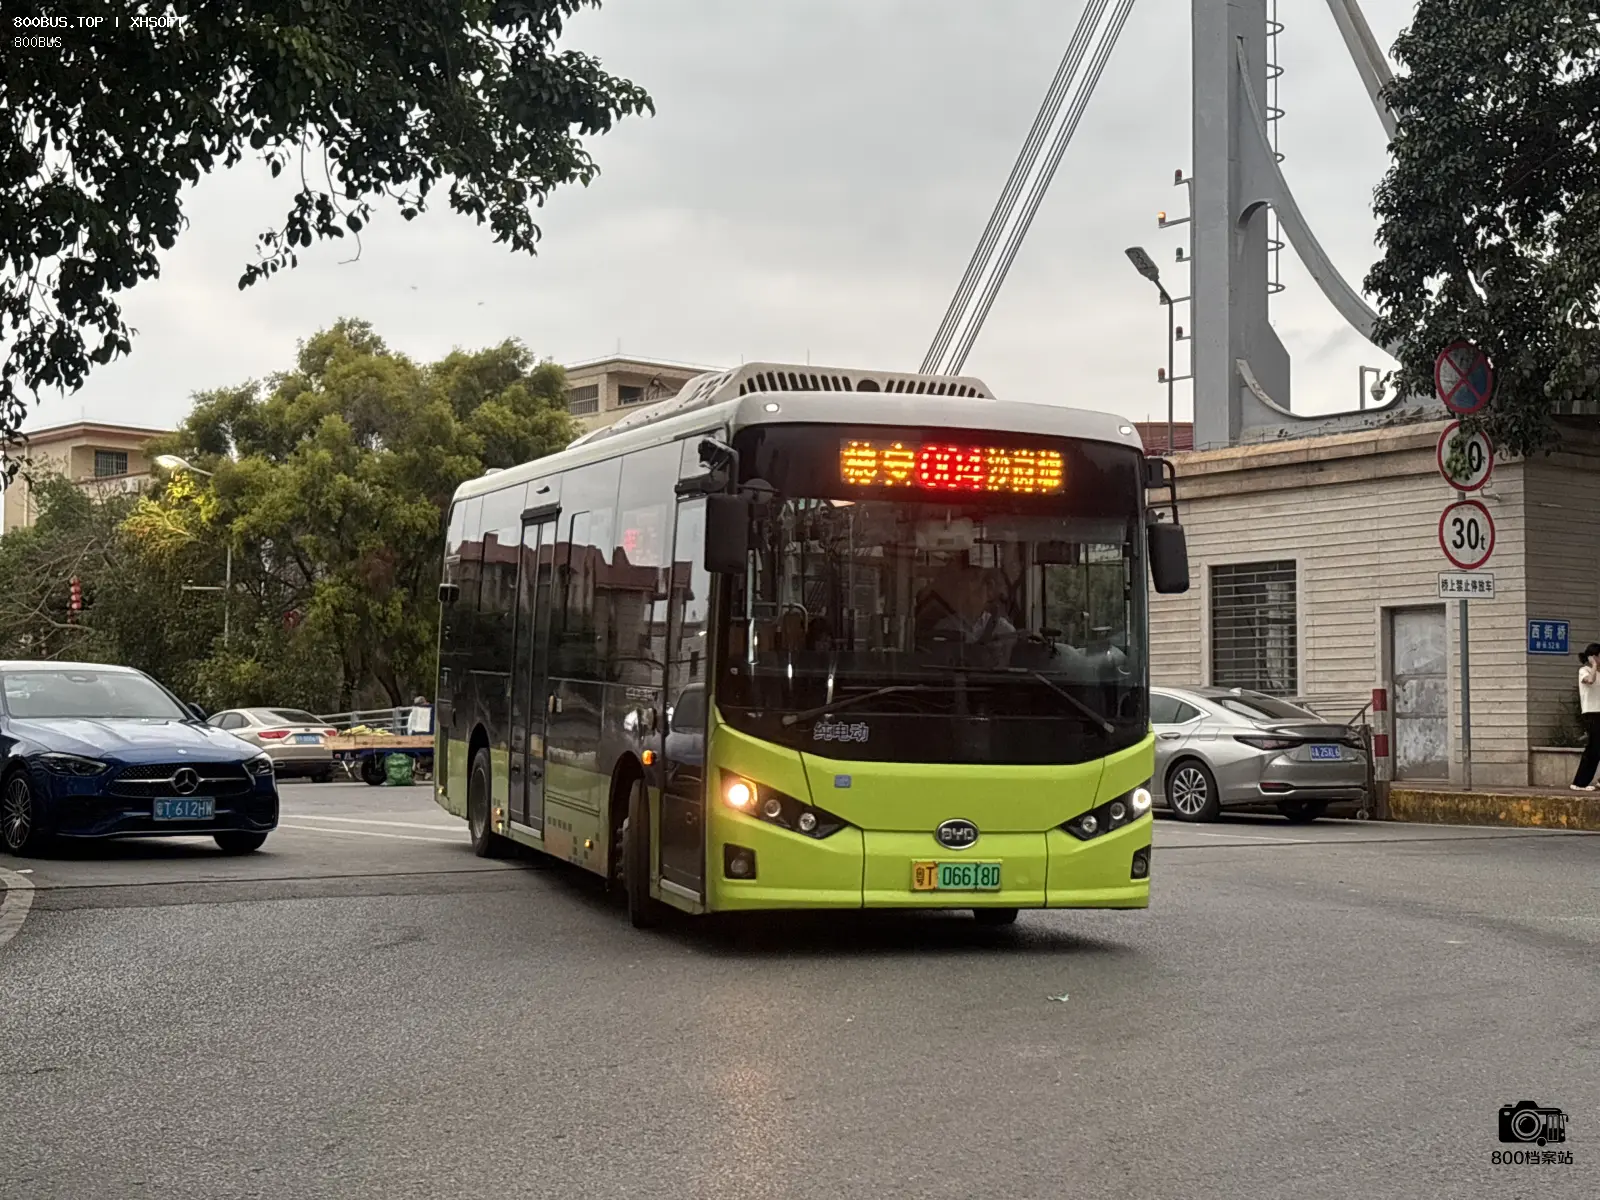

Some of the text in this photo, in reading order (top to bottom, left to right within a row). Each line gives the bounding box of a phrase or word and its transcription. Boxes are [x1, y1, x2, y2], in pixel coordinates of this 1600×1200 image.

[1451, 517, 1486, 551] 30t
[1531, 624, 1566, 640] 西街桥
[813, 721, 869, 742] 纯电动
[941, 827, 974, 840] BYD
